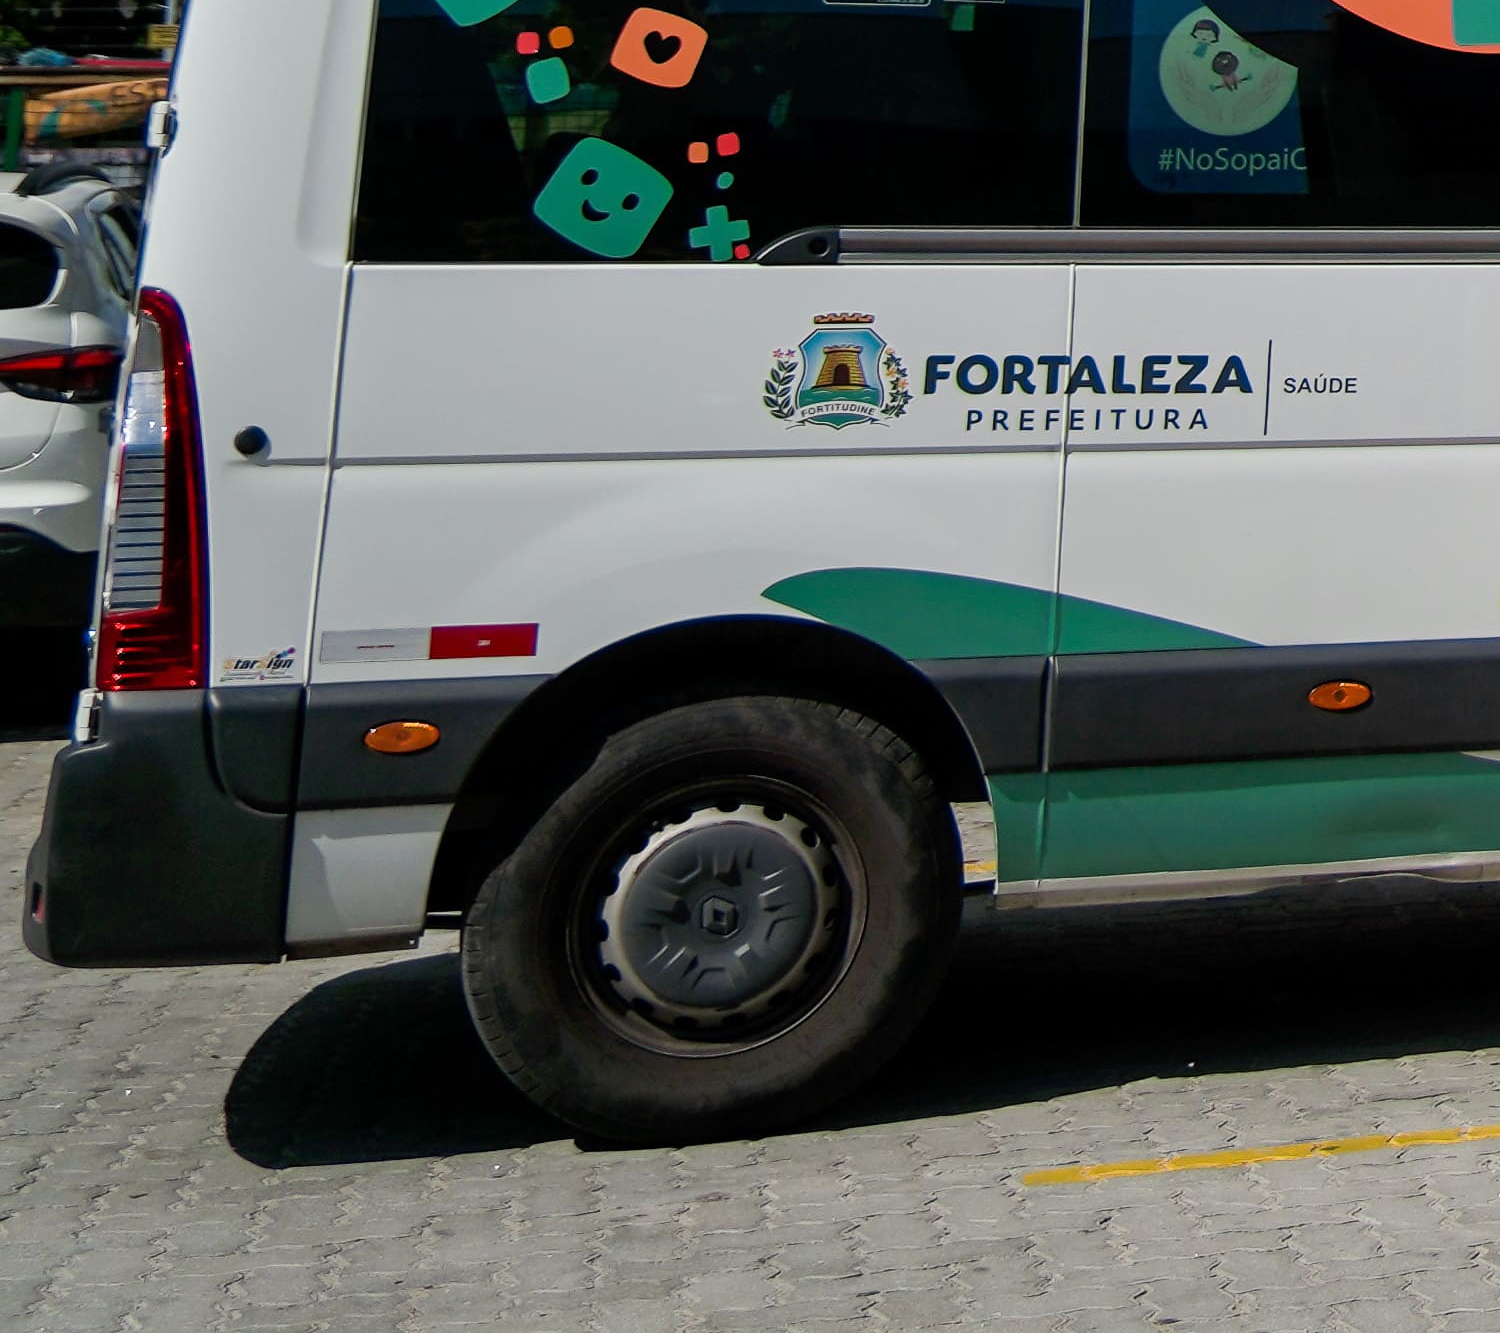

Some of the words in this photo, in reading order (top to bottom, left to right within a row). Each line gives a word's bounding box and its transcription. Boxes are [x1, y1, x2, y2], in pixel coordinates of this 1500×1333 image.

[924, 353, 1253, 395] FORTALEZA
[1283, 371, 1358, 394] SAÚDE
[801, 403, 877, 417] FORTITUDINE
[966, 408, 1209, 432] PREFEITURA
